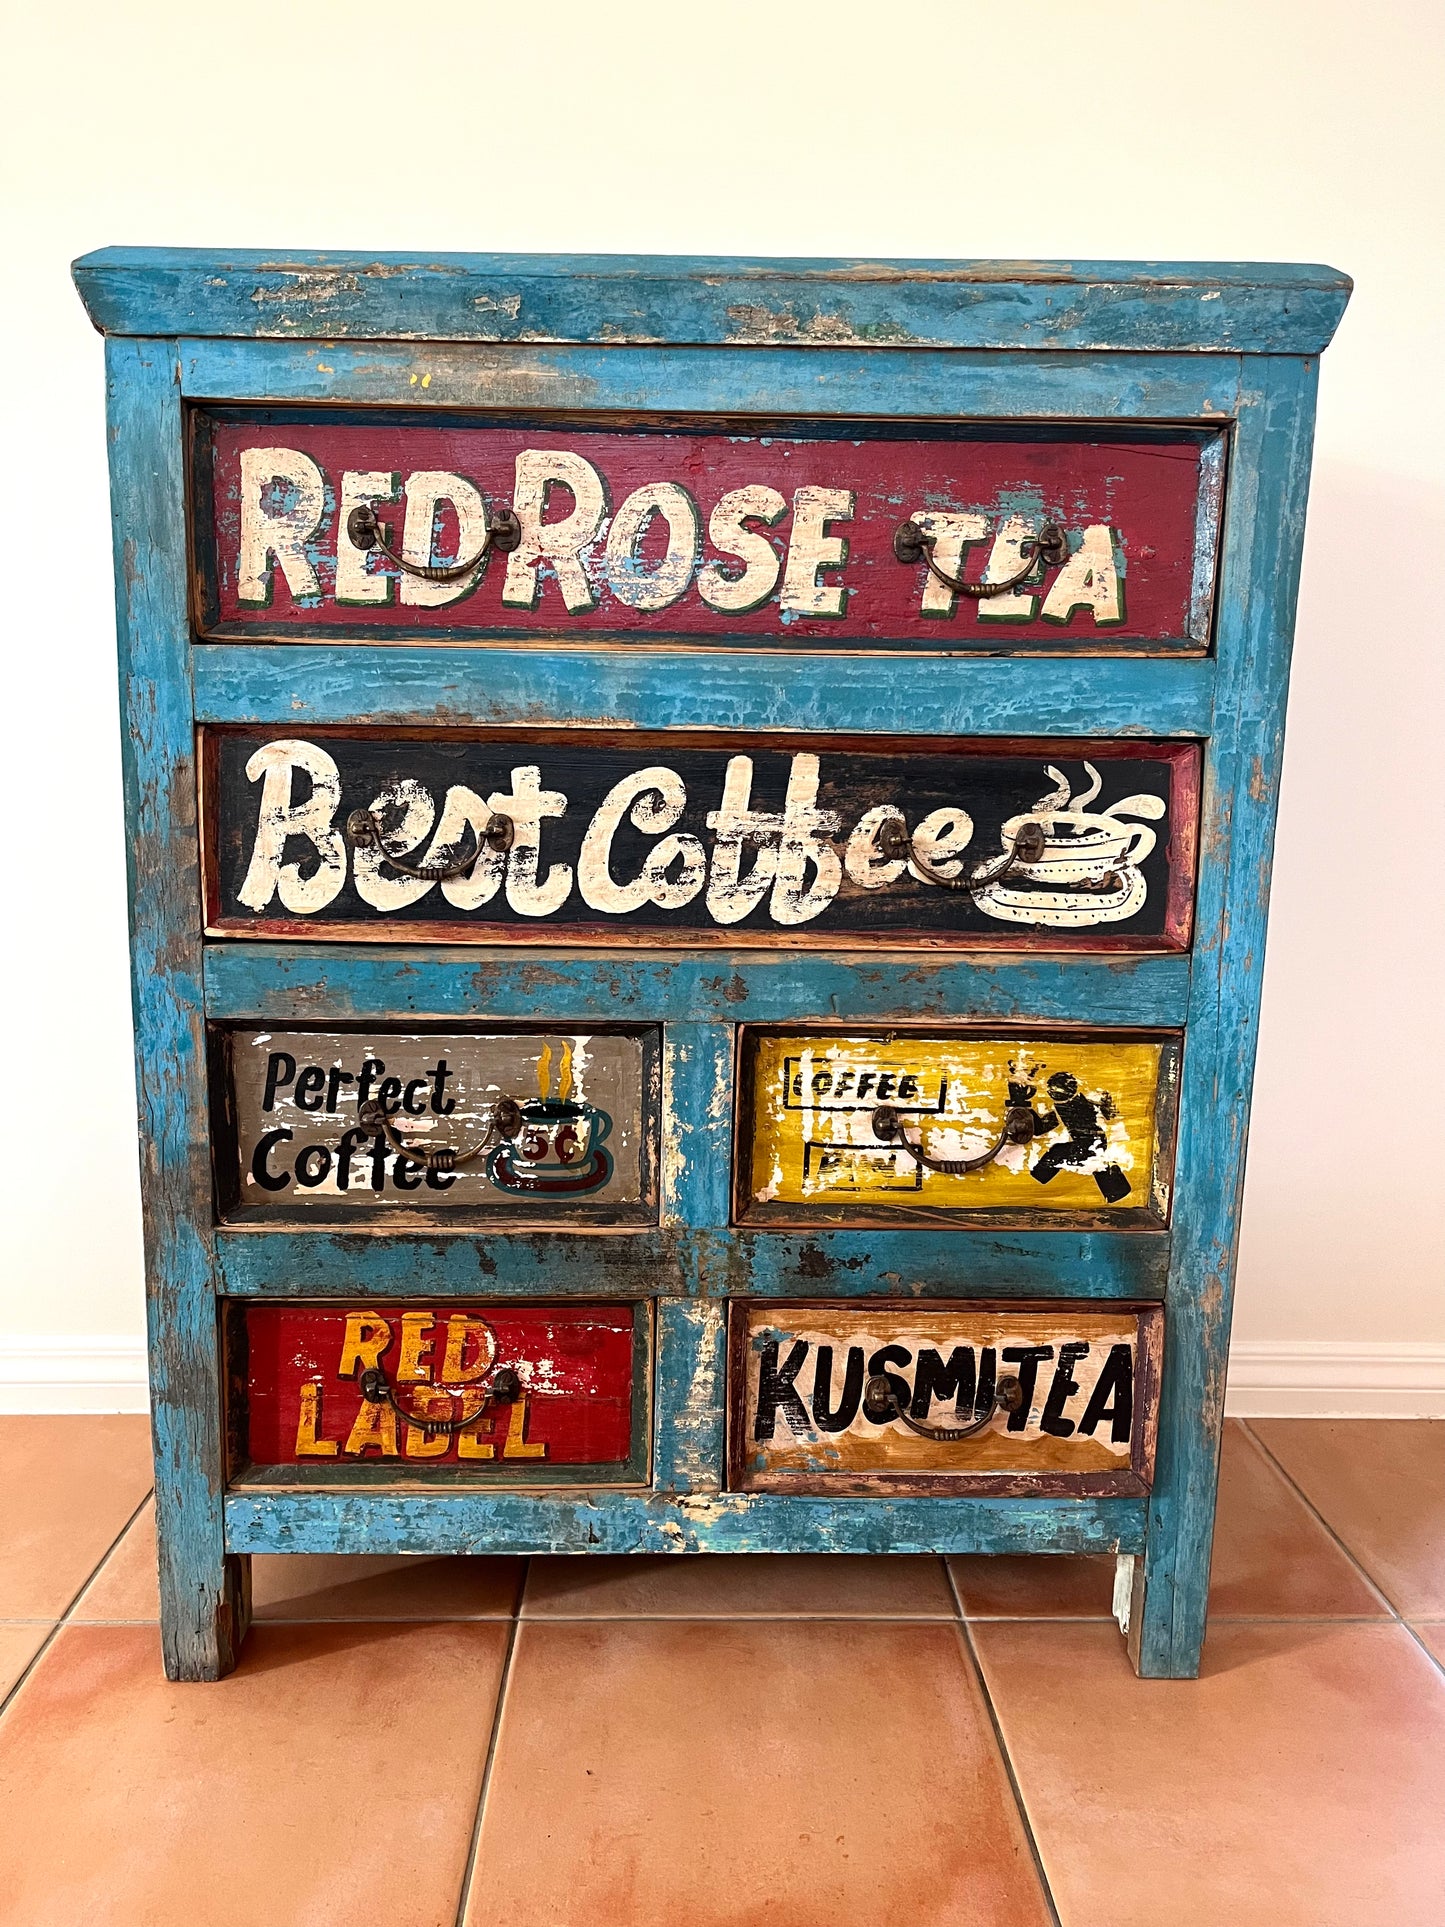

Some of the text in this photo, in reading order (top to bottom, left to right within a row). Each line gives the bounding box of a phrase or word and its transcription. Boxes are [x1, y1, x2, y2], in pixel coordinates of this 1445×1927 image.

[238, 447, 1127, 627] RED ROSE TEA
[236, 739, 574, 917] Best
[262, 1051, 457, 1116] Perfect
[251, 1127, 459, 1193] Coffee
[336, 1310, 495, 1385] RED
[295, 1382, 549, 1460] LABEL
